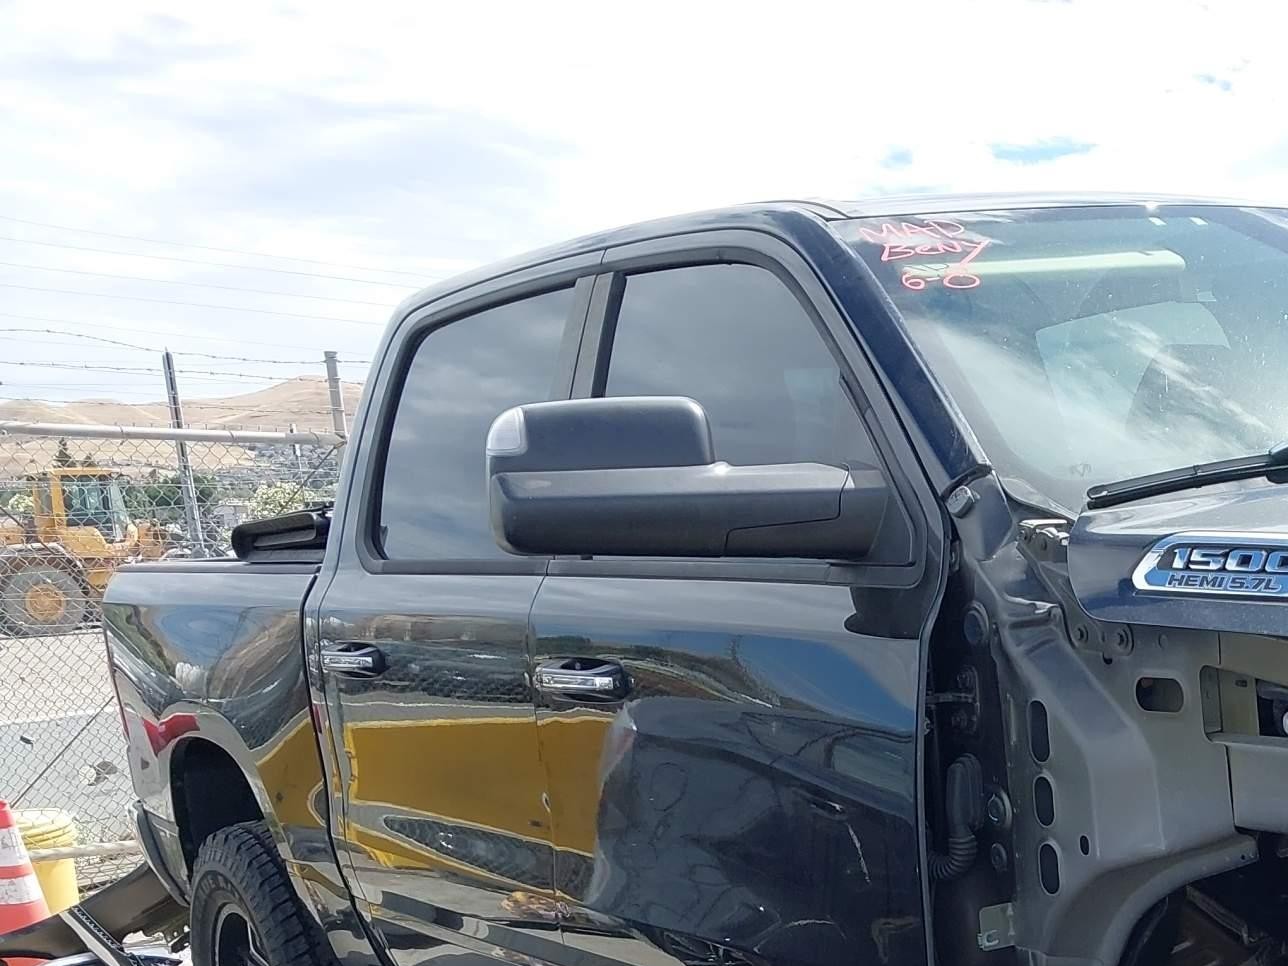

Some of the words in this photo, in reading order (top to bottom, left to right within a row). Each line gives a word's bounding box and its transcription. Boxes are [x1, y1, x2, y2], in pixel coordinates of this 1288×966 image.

[859, 219, 965, 243] MAD
[1167, 573, 1224, 589] HEMI
[1228, 575, 1281, 592] 5.7L
